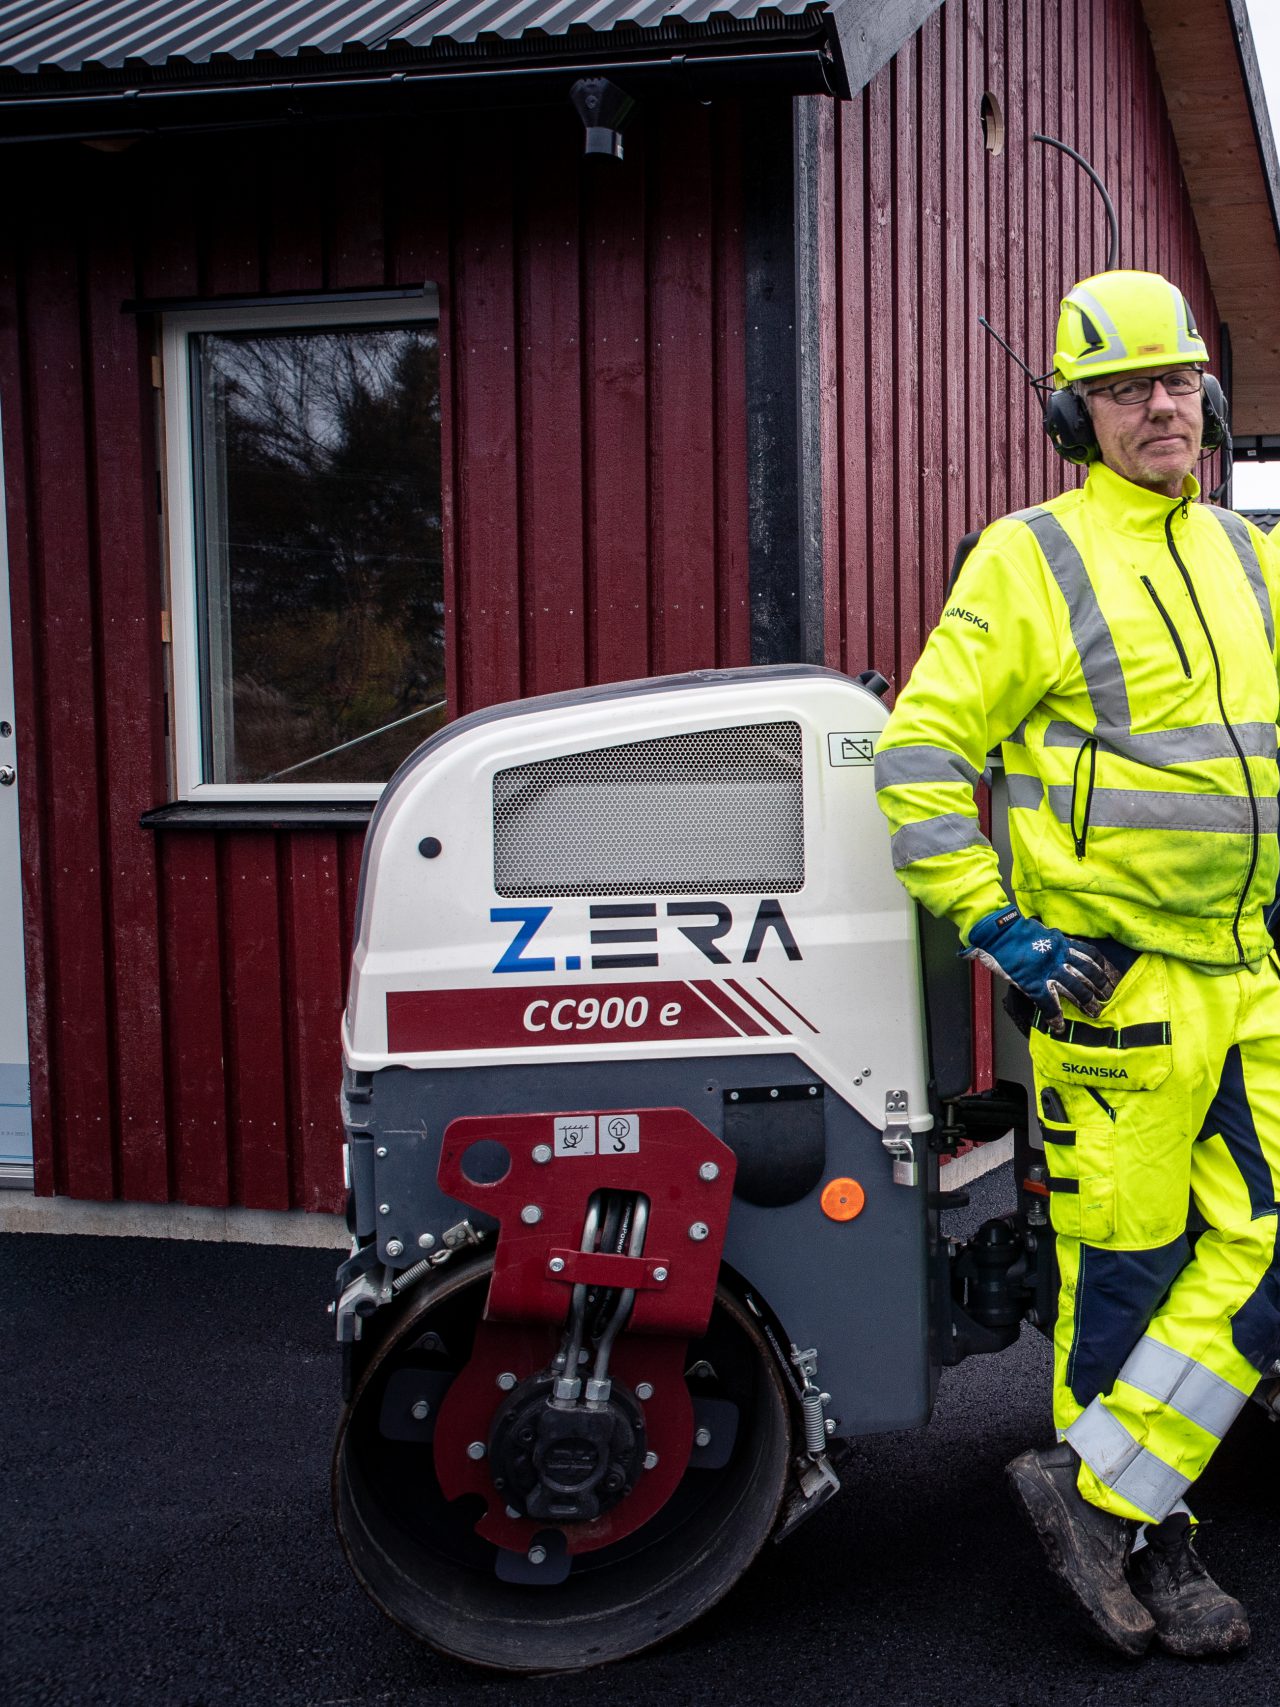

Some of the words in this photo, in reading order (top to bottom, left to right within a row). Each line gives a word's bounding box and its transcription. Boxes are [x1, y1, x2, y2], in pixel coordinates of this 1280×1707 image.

[944, 607, 989, 633] KANSKA
[522, 996, 649, 1032] CC900
[659, 1002, 682, 1027] e
[1061, 1062, 1129, 1079] SKANSKA
